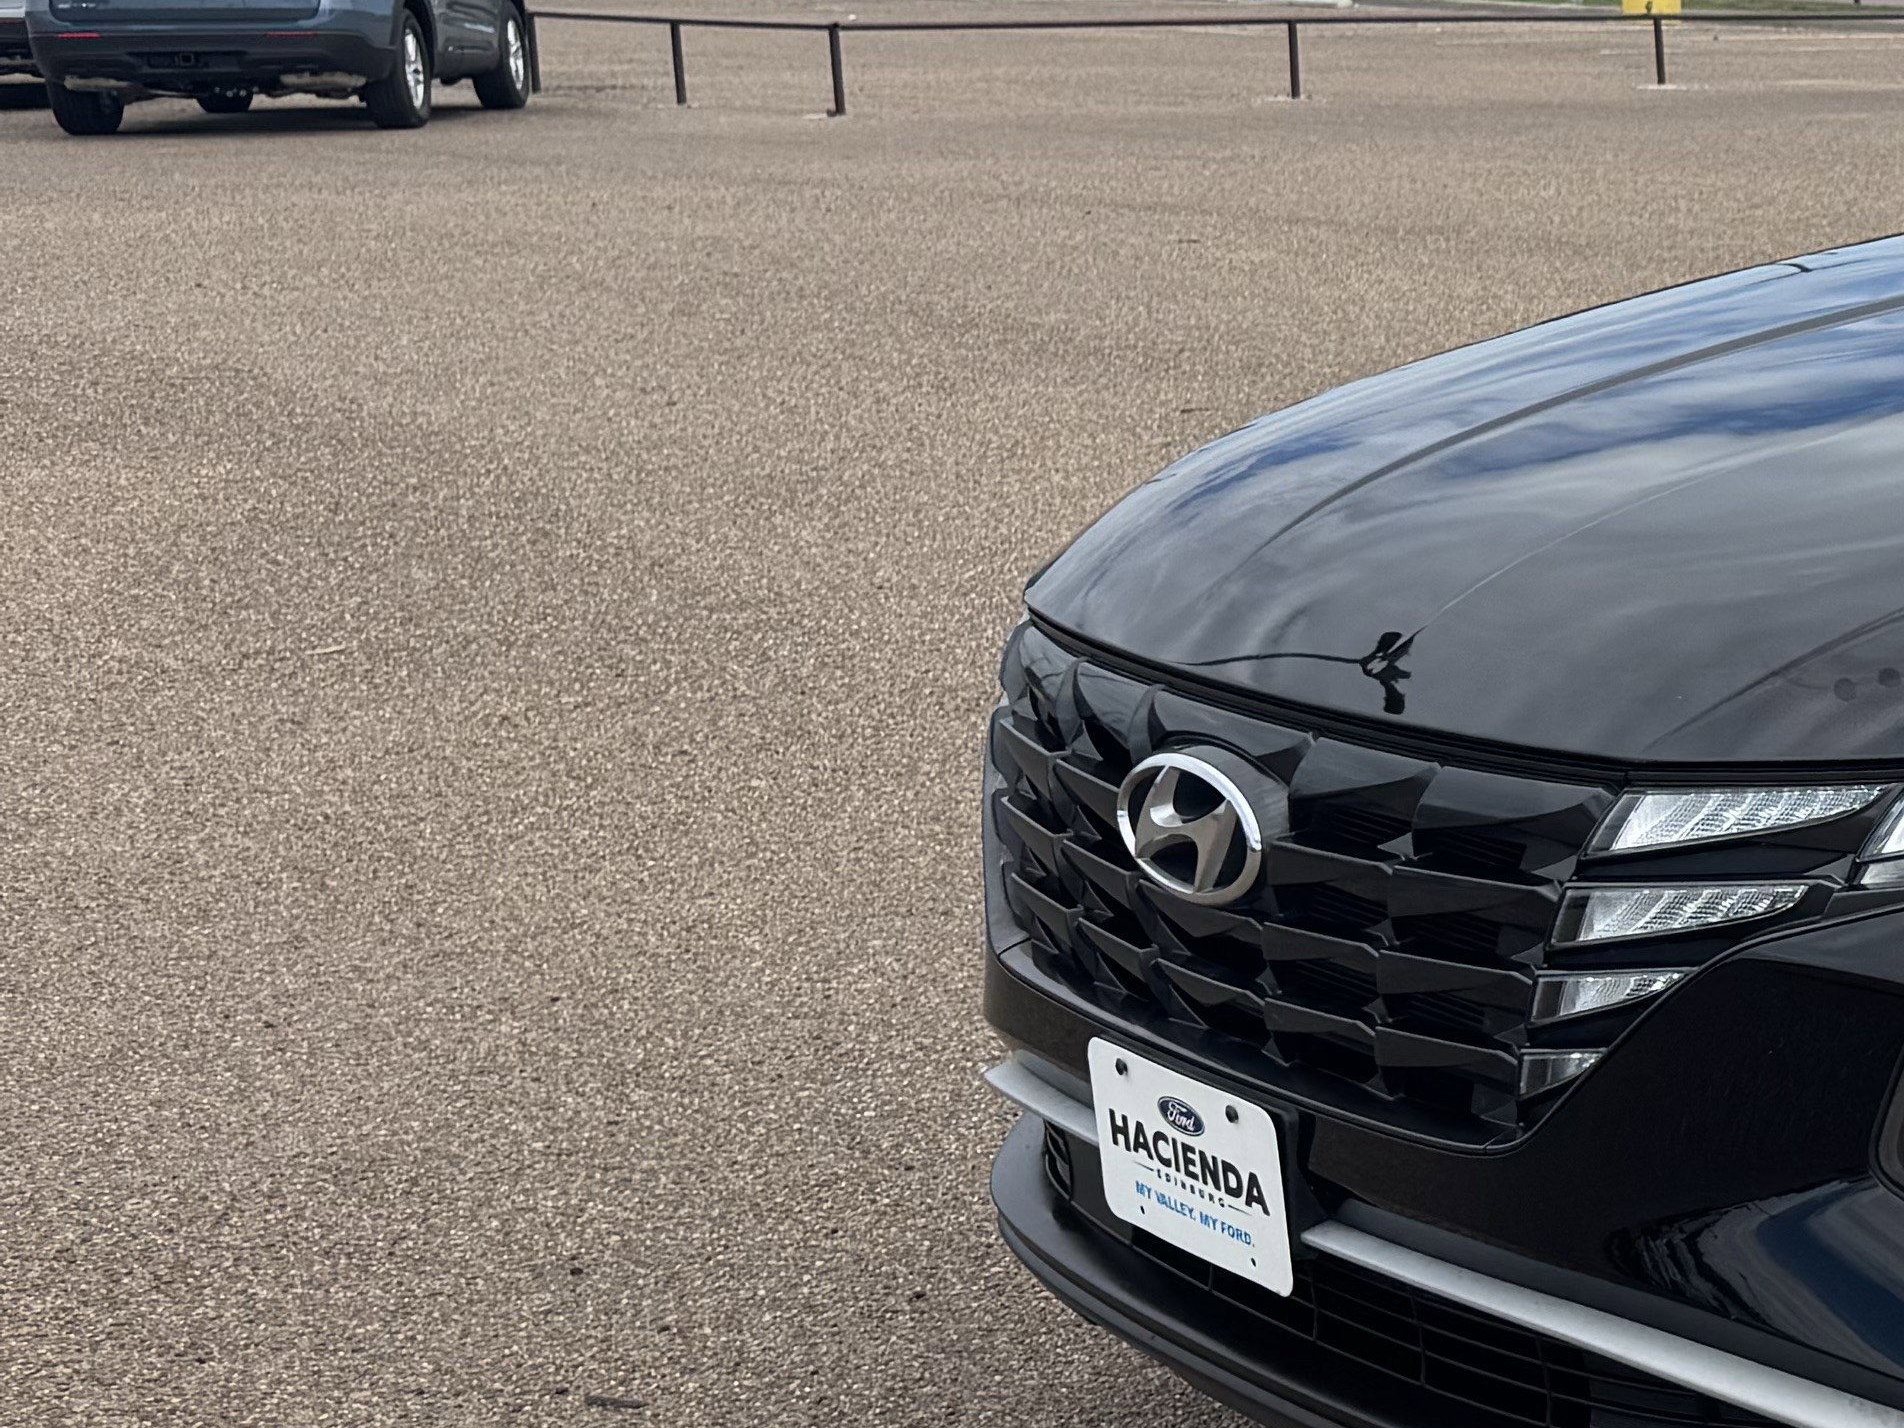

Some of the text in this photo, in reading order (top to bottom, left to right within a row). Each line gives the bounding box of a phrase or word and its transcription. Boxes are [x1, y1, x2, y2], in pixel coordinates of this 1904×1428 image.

[1108, 1107, 1271, 1217] HACIENDA
[1156, 1168, 1226, 1208] EDINBURG
[1135, 1180, 1256, 1248] MY VALLEY, MY FORD.
